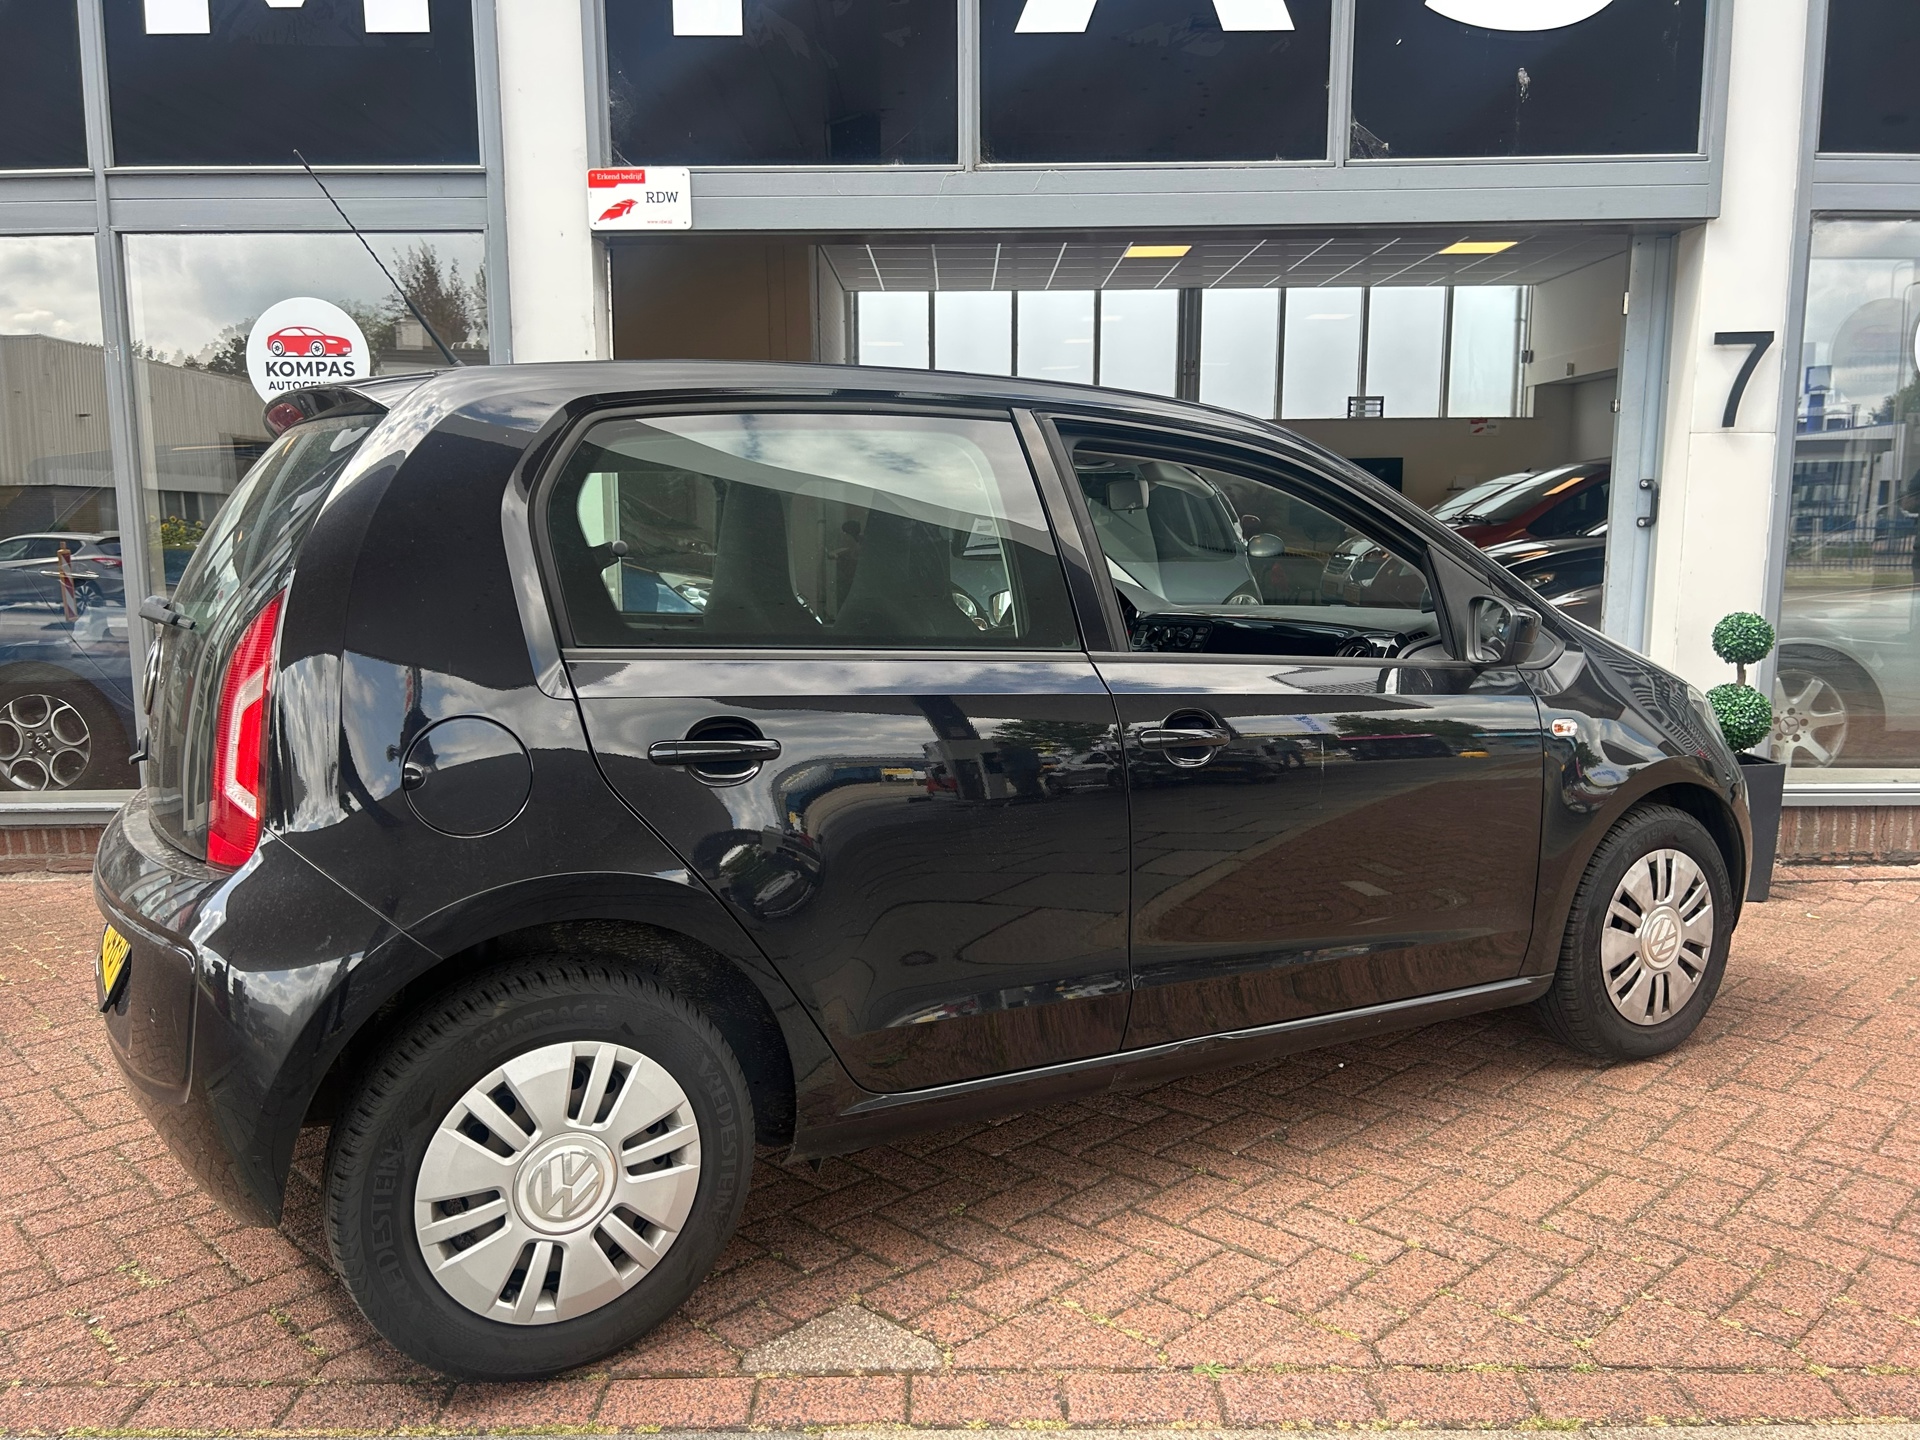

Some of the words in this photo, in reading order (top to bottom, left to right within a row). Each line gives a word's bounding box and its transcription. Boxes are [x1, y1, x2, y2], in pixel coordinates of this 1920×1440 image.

[596, 173, 620, 181] Erkend
[621, 173, 643, 182] bedrijf
[645, 191, 679, 204] RDW
[265, 361, 356, 377] KOMPAS
[1713, 331, 1775, 429] 7
